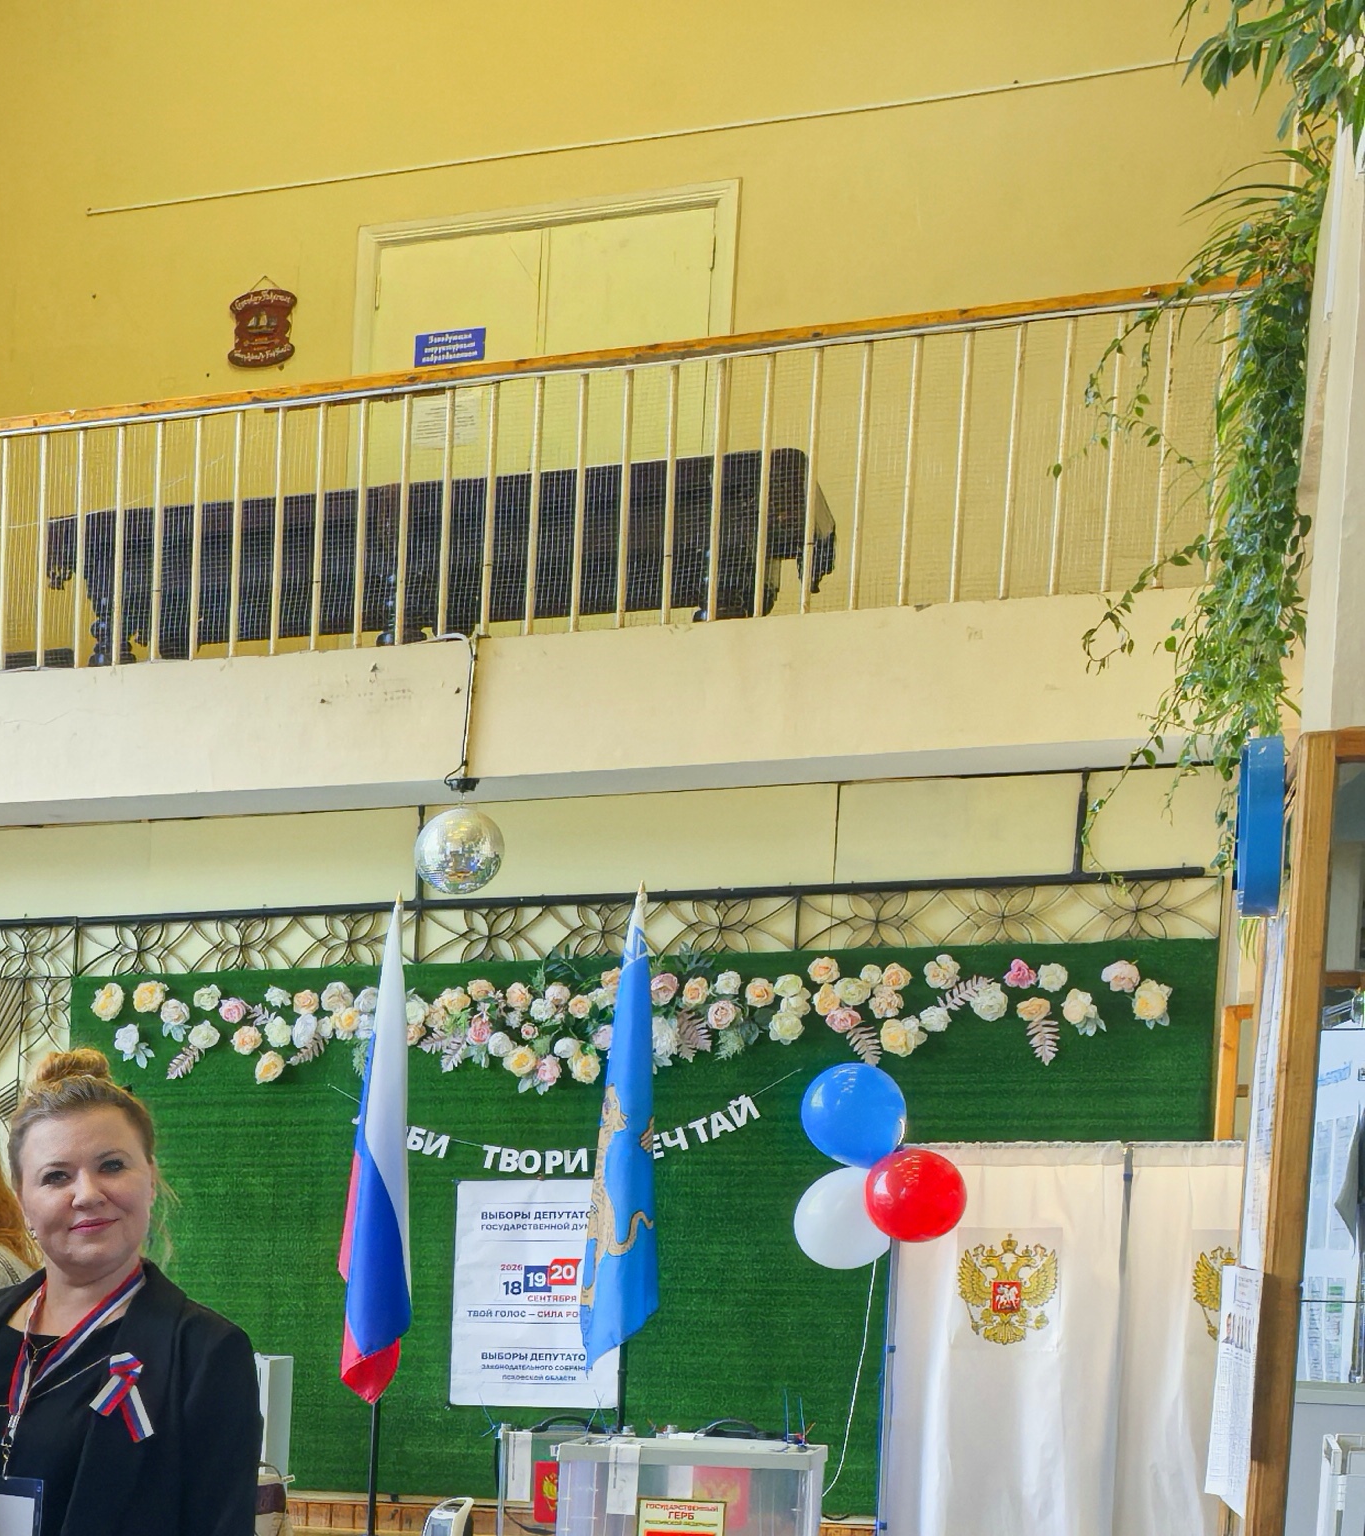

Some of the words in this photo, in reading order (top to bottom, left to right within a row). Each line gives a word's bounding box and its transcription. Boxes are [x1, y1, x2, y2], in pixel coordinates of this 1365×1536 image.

[482, 1145, 588, 1174] ТВОРИ
[653, 1094, 761, 1160] ЕЧТАЙ
[481, 1211, 531, 1220] ВЫБОРЫ
[534, 1211, 590, 1220] ДЕПУТАТО
[481, 1222, 570, 1231] ГОСУДАРСТВЕННОЙ
[502, 1281, 522, 1295] 18
[526, 1272, 546, 1287] 19
[550, 1264, 575, 1280] 20
[468, 1309, 493, 1318] ТВОЙ
[481, 1352, 528, 1360] ВЫБОРЫ
[530, 1353, 586, 1362] ДЕПУТАТО
[668, 1511, 695, 1520] ГЕРБ
